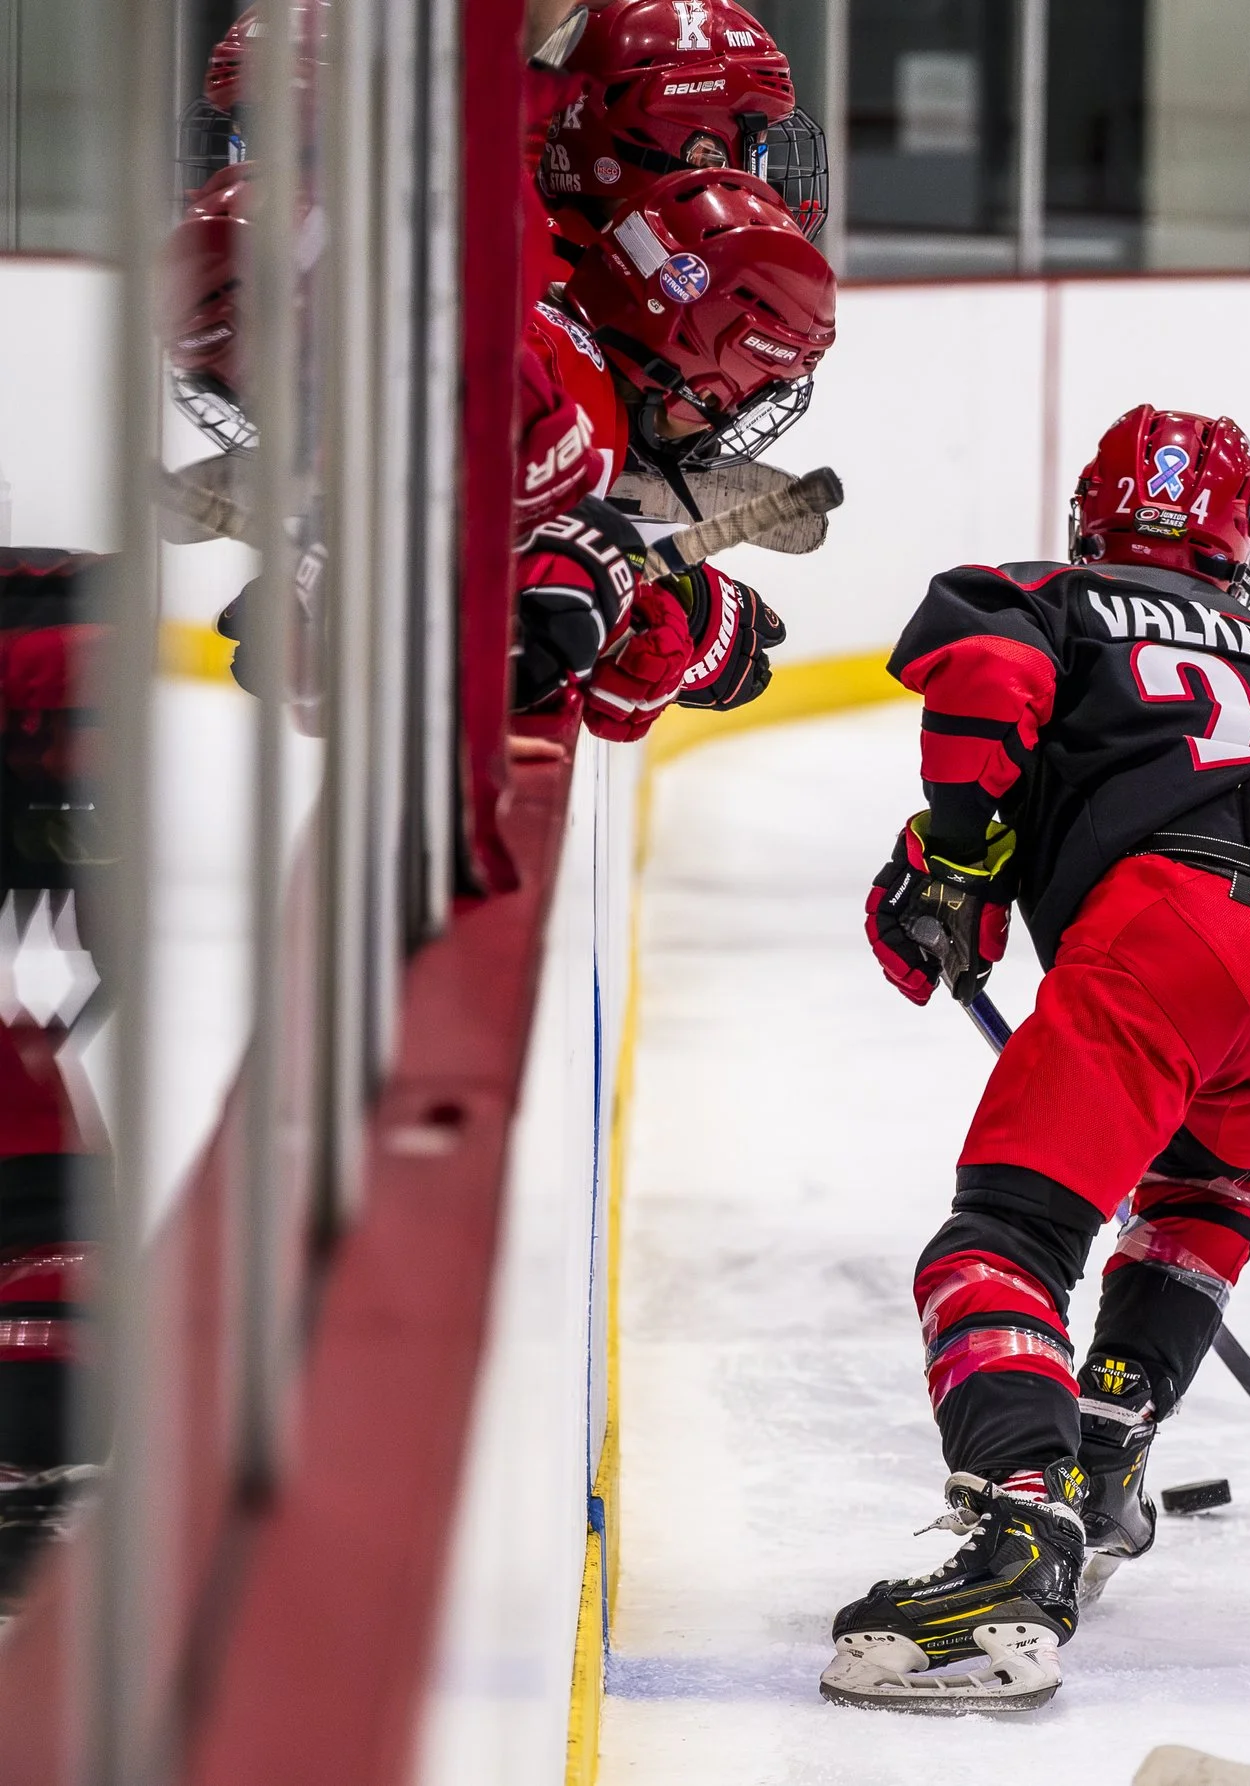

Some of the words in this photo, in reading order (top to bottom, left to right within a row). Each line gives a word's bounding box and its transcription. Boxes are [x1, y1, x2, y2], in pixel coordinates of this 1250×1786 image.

[673, 1, 710, 50] K
[664, 79, 725, 96] BAUER
[682, 256, 705, 283] 72
[743, 336, 796, 361] BAUER
[681, 576, 738, 688] RRIOR
[912, 1579, 964, 1597] BAUER
